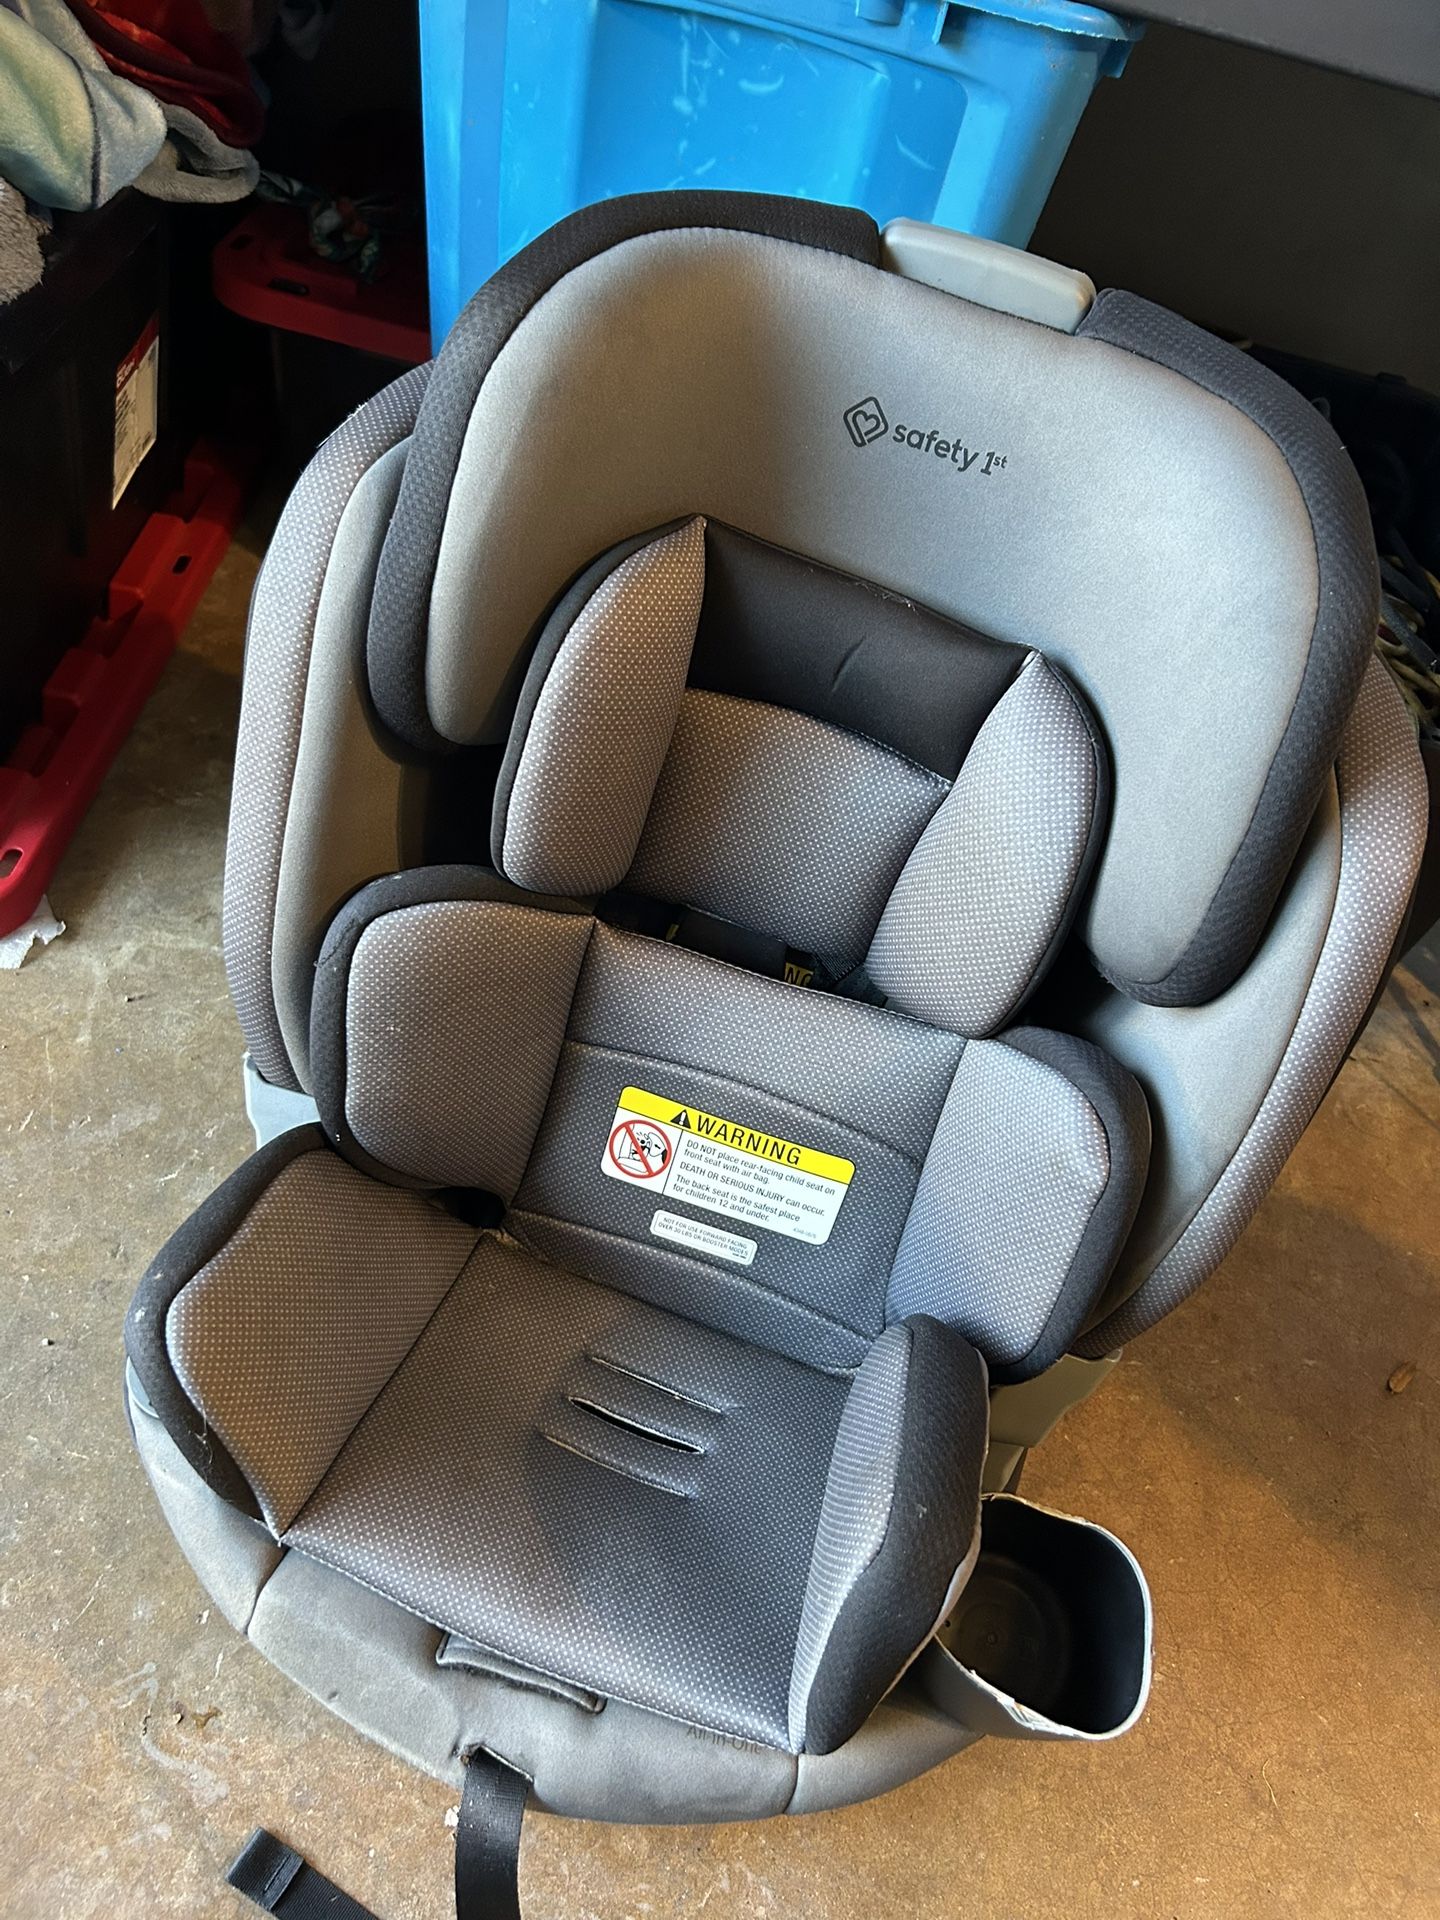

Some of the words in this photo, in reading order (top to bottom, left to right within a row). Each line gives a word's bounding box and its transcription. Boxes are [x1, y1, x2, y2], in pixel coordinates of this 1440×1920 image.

[892, 424, 980, 473] safety
[684, 1148, 703, 1161] front
[703, 1157, 722, 1168] seat
[723, 1163, 740, 1174] with
[741, 1170, 752, 1178] air
[698, 1115, 801, 1165] WARNING
[679, 1161, 707, 1177] DEATH
[707, 1170, 719, 1181] OR
[719, 1175, 755, 1193] SERIOUS
[755, 1187, 785, 1202] INJURY
[785, 1198, 801, 1208] can
[686, 1139, 699, 1150] DO
[699, 1144, 716, 1156] NOT
[717, 1152, 740, 1164] place
[740, 1160, 784, 1181] rear-facing
[785, 1174, 805, 1186] child
[805, 1182, 824, 1192] seat
[824, 1187, 836, 1196] on
[673, 1183, 685, 1193] for
[685, 1188, 717, 1204] children
[719, 1199, 729, 1208] 12
[729, 1204, 746, 1214] and
[676, 1174, 691, 1186] The
[691, 1180, 711, 1193] back
[712, 1188, 730, 1199] seat
[730, 1194, 738, 1202] is
[739, 1196, 753, 1207] the
[753, 1202, 778, 1215] safest
[778, 1210, 801, 1222] place
